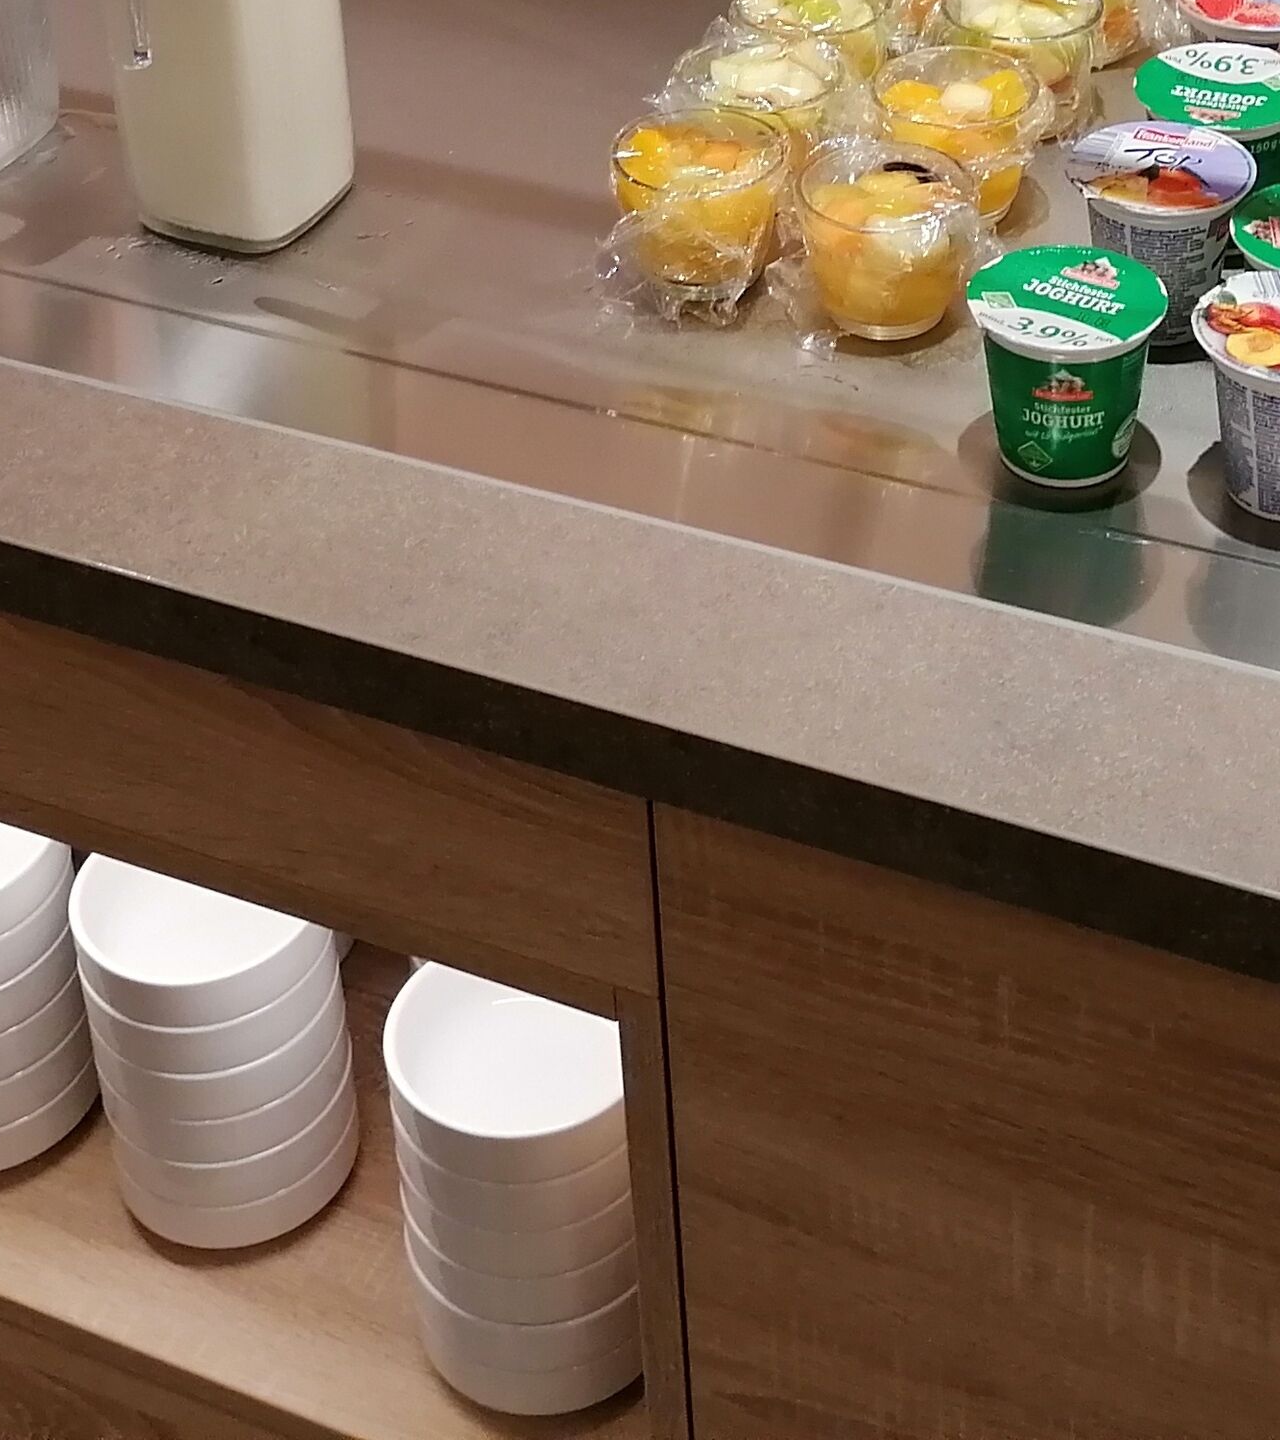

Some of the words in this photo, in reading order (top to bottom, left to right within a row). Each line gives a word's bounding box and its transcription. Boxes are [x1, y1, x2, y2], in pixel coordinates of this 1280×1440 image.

[1185, 49, 1260, 75] 3,9%
[1171, 84, 1268, 107] JOGHURT
[1023, 278, 1125, 315] JOGHURT
[1008, 317, 1089, 347] 3,9%
[1022, 408, 1105, 429] JOGHURT
